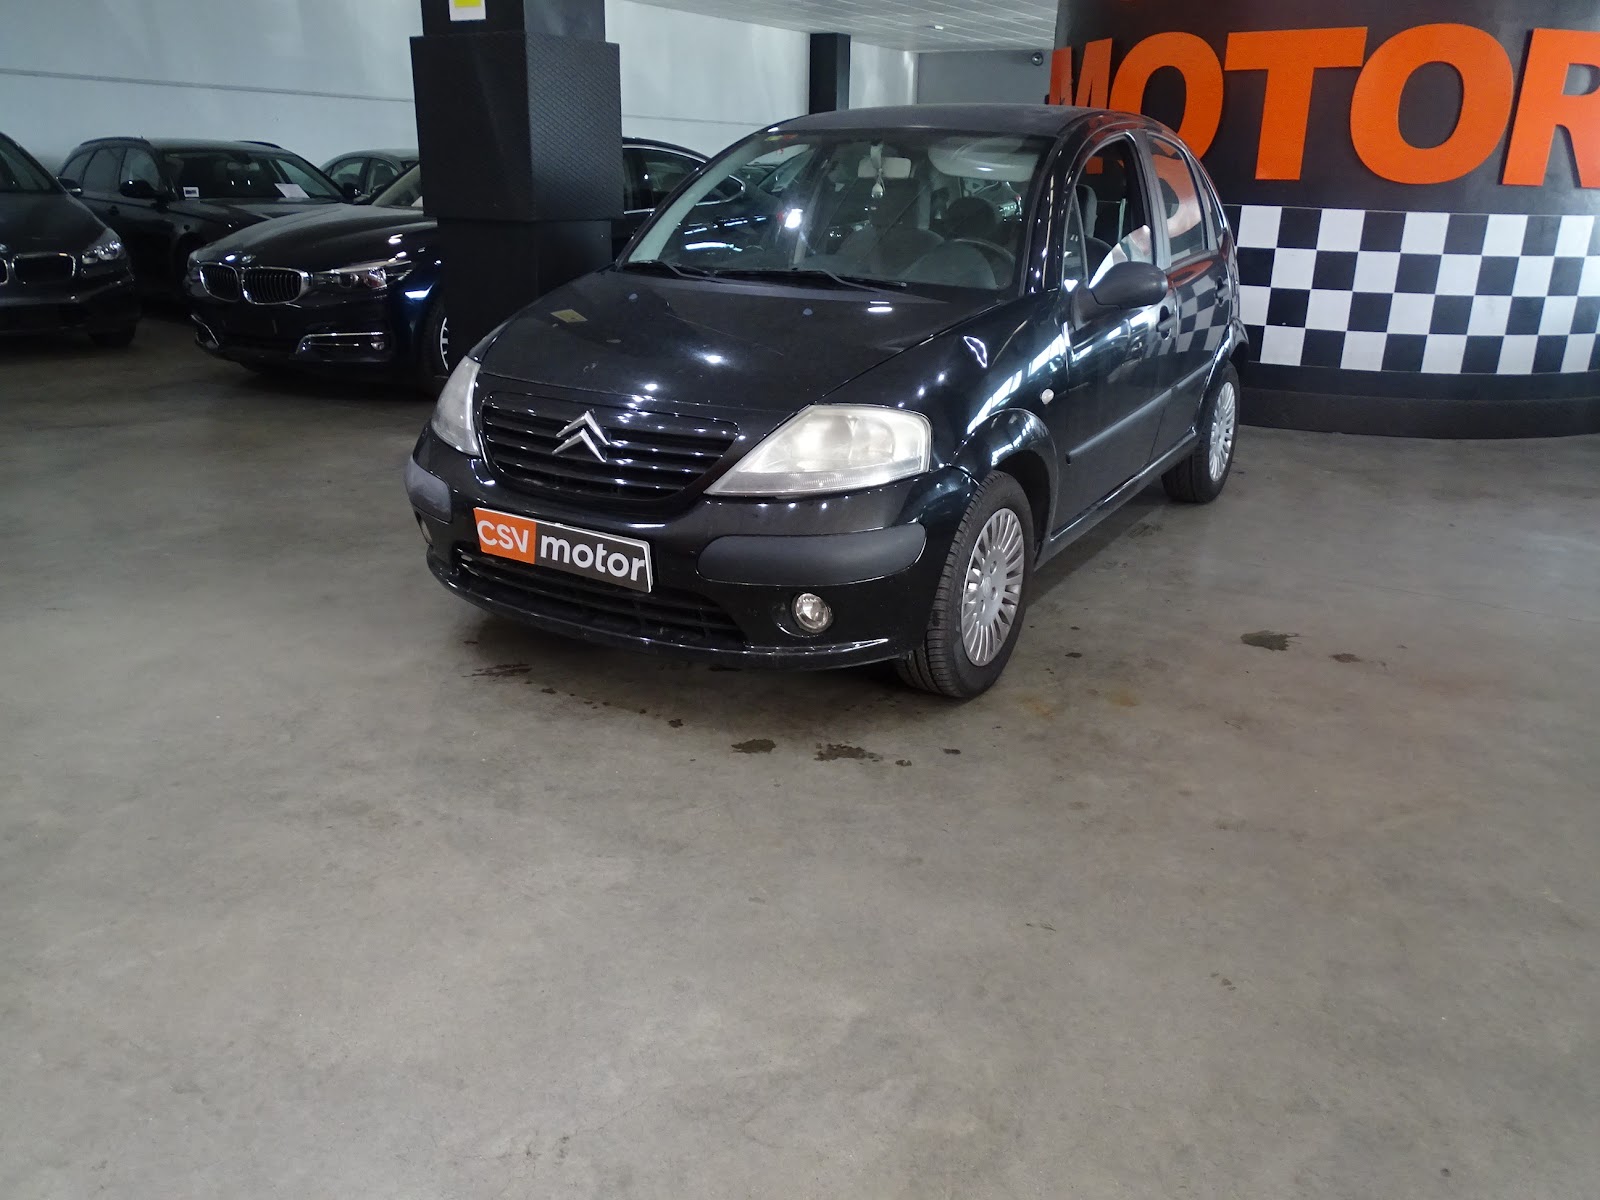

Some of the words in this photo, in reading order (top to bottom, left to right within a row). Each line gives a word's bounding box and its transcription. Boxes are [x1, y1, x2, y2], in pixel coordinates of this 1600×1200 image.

[1049, 23, 1600, 188] MOTOR
[477, 520, 529, 553] CSV
[540, 535, 645, 581] motor
